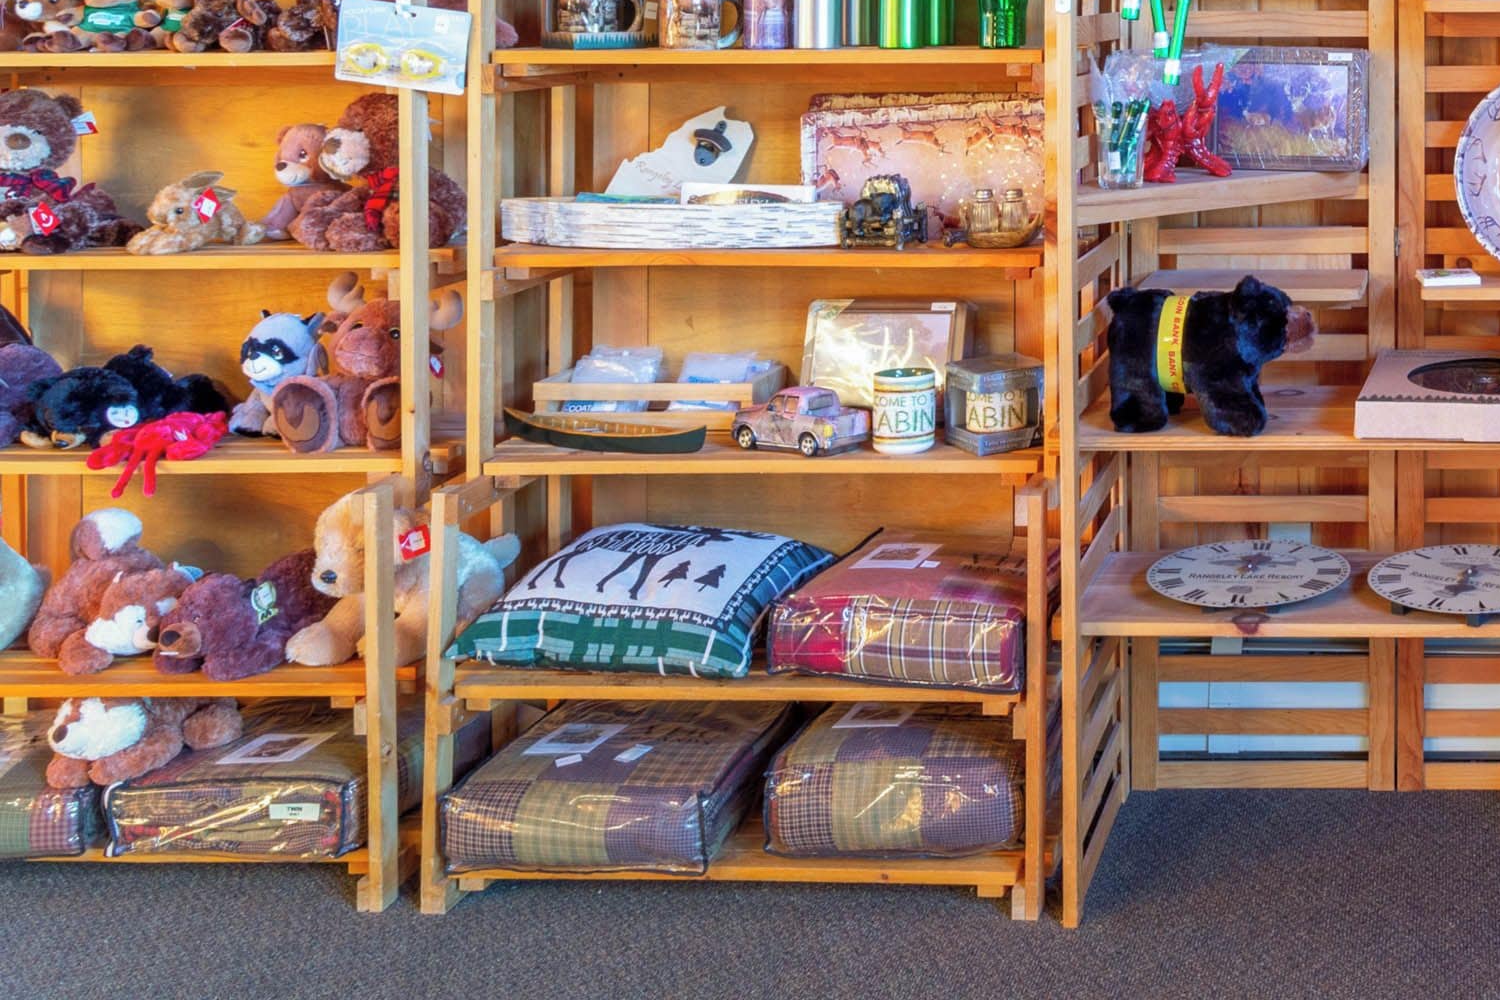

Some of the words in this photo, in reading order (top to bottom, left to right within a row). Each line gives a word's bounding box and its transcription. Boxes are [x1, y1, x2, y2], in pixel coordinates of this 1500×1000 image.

[912, 393, 928, 407] TO
[1188, 572, 1238, 580] RANGELEY
[1267, 572, 1305, 580] RESORT
